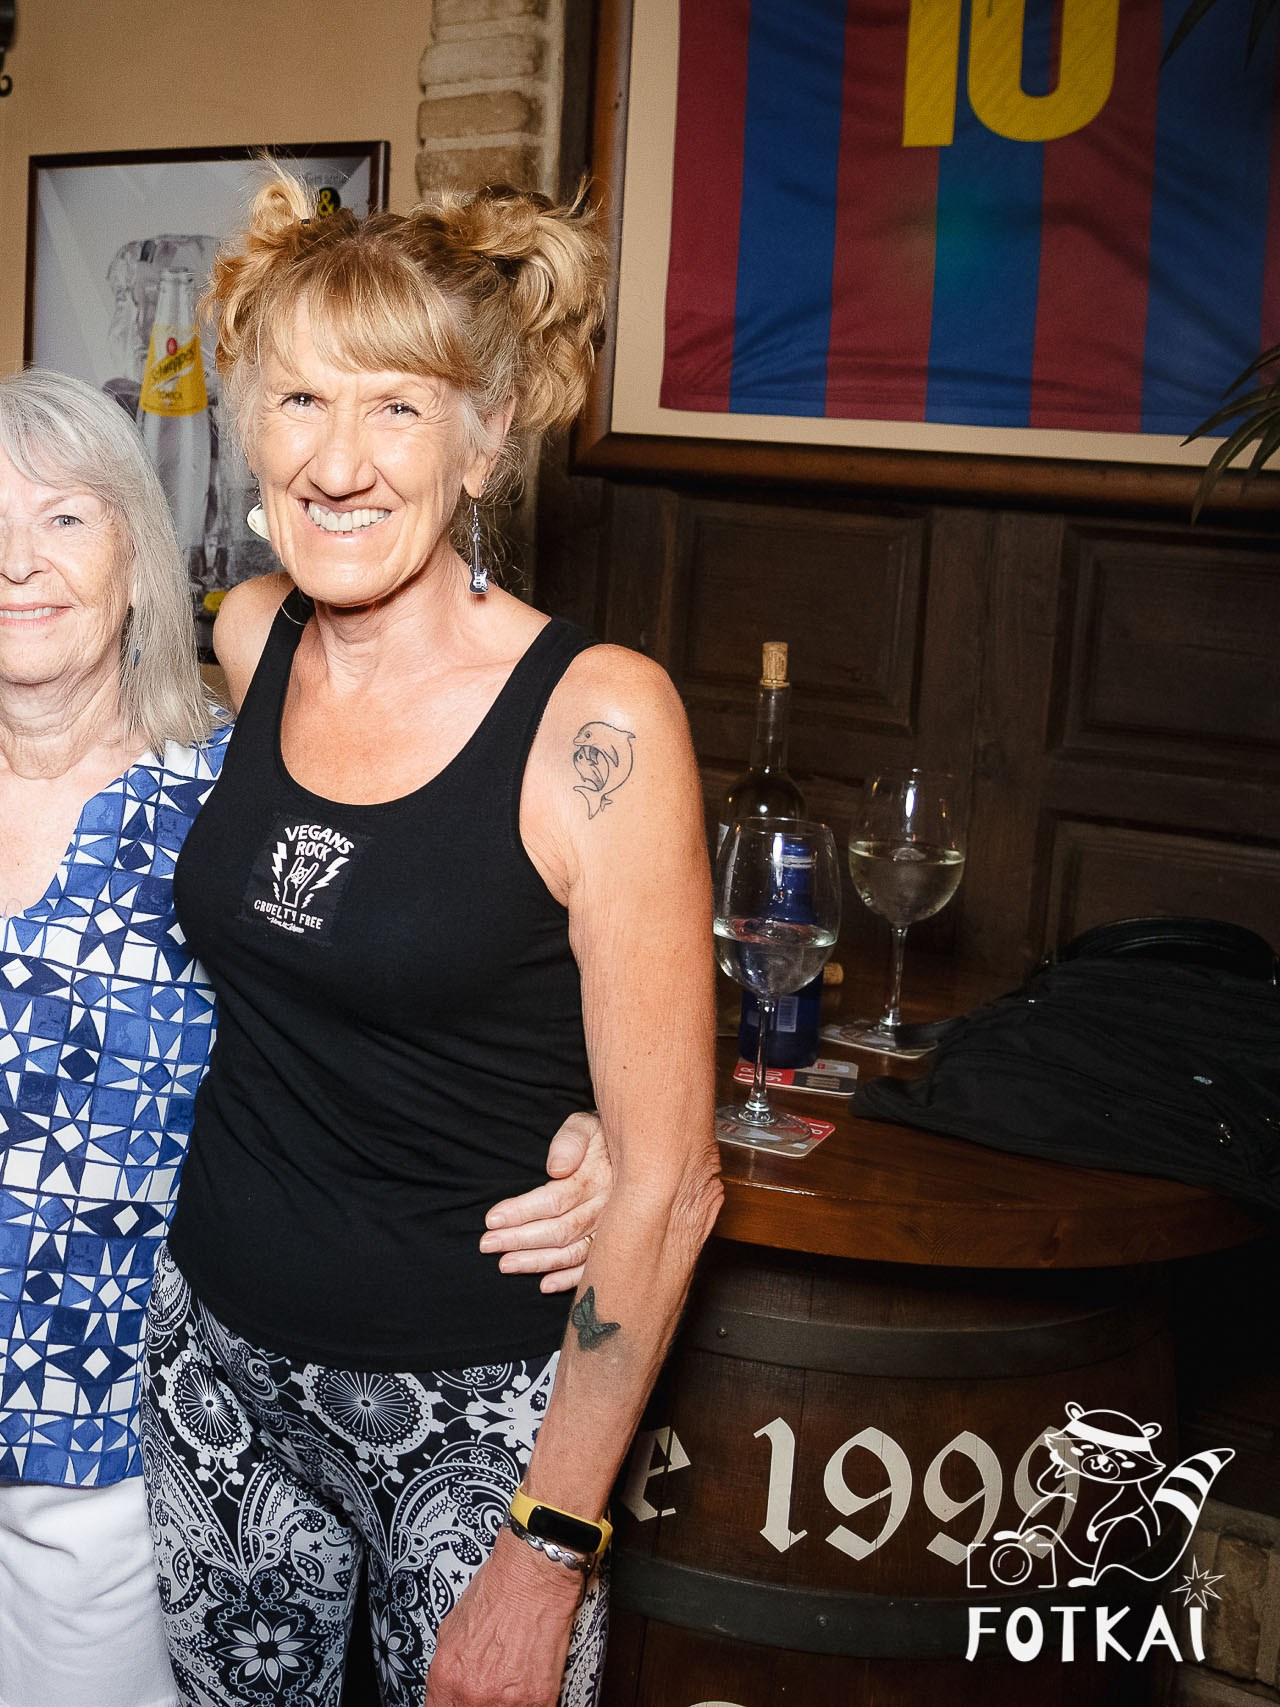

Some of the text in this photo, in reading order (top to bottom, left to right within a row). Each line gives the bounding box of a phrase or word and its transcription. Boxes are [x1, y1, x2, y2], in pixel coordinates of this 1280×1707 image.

[284, 824, 355, 855] VEGANS
[294, 841, 332, 862] ROCK
[253, 899, 297, 922] CRUELTY
[298, 913, 324, 930] FREE
[753, 1416, 1081, 1565] 1999
